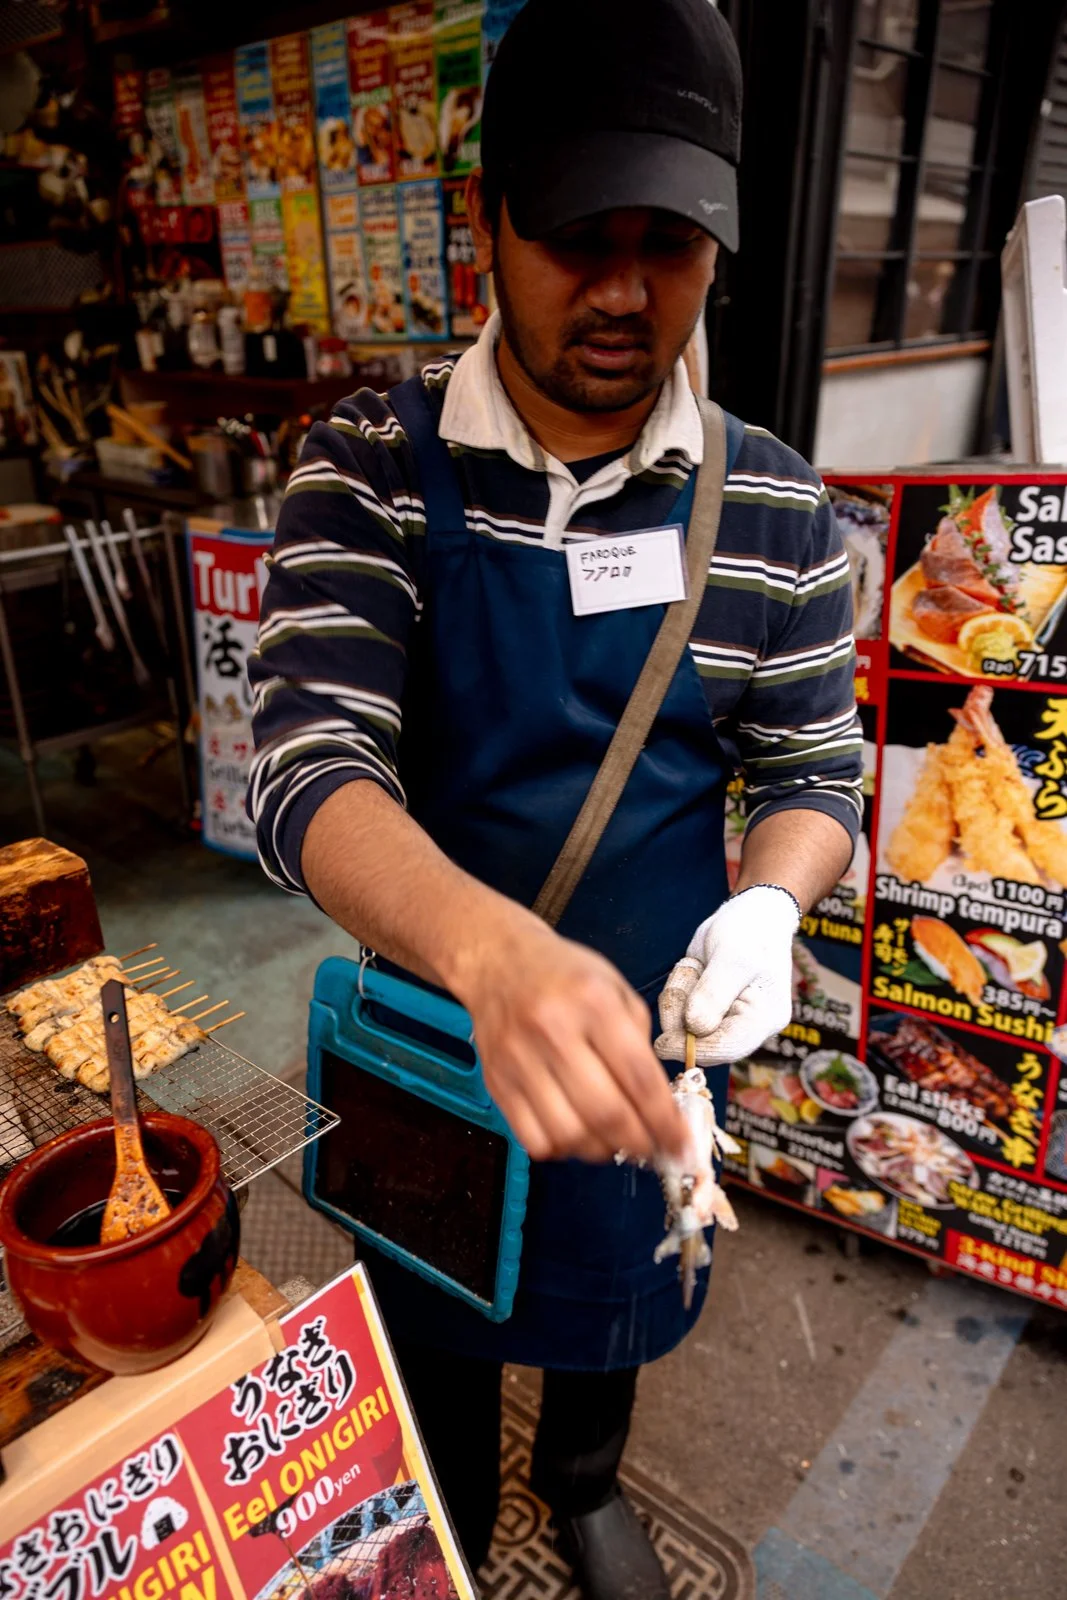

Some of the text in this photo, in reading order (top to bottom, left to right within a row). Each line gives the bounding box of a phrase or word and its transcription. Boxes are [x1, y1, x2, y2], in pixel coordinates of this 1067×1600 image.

[580, 545, 637, 565] FAROQUE
[1010, 526, 1067, 563] Sas
[821, 917, 863, 944] tuna
[875, 877, 1063, 939] Shrimp tempura
[873, 976, 1056, 1043] Salmon Sushi
[883, 1074, 987, 1122] Eel sticks
[937, 1108, 998, 1146] 800円
[233, 1318, 333, 1423] うなぎ
[225, 1353, 354, 1482] おにぎり
[222, 1386, 390, 1541] Eel ONIGIRI
